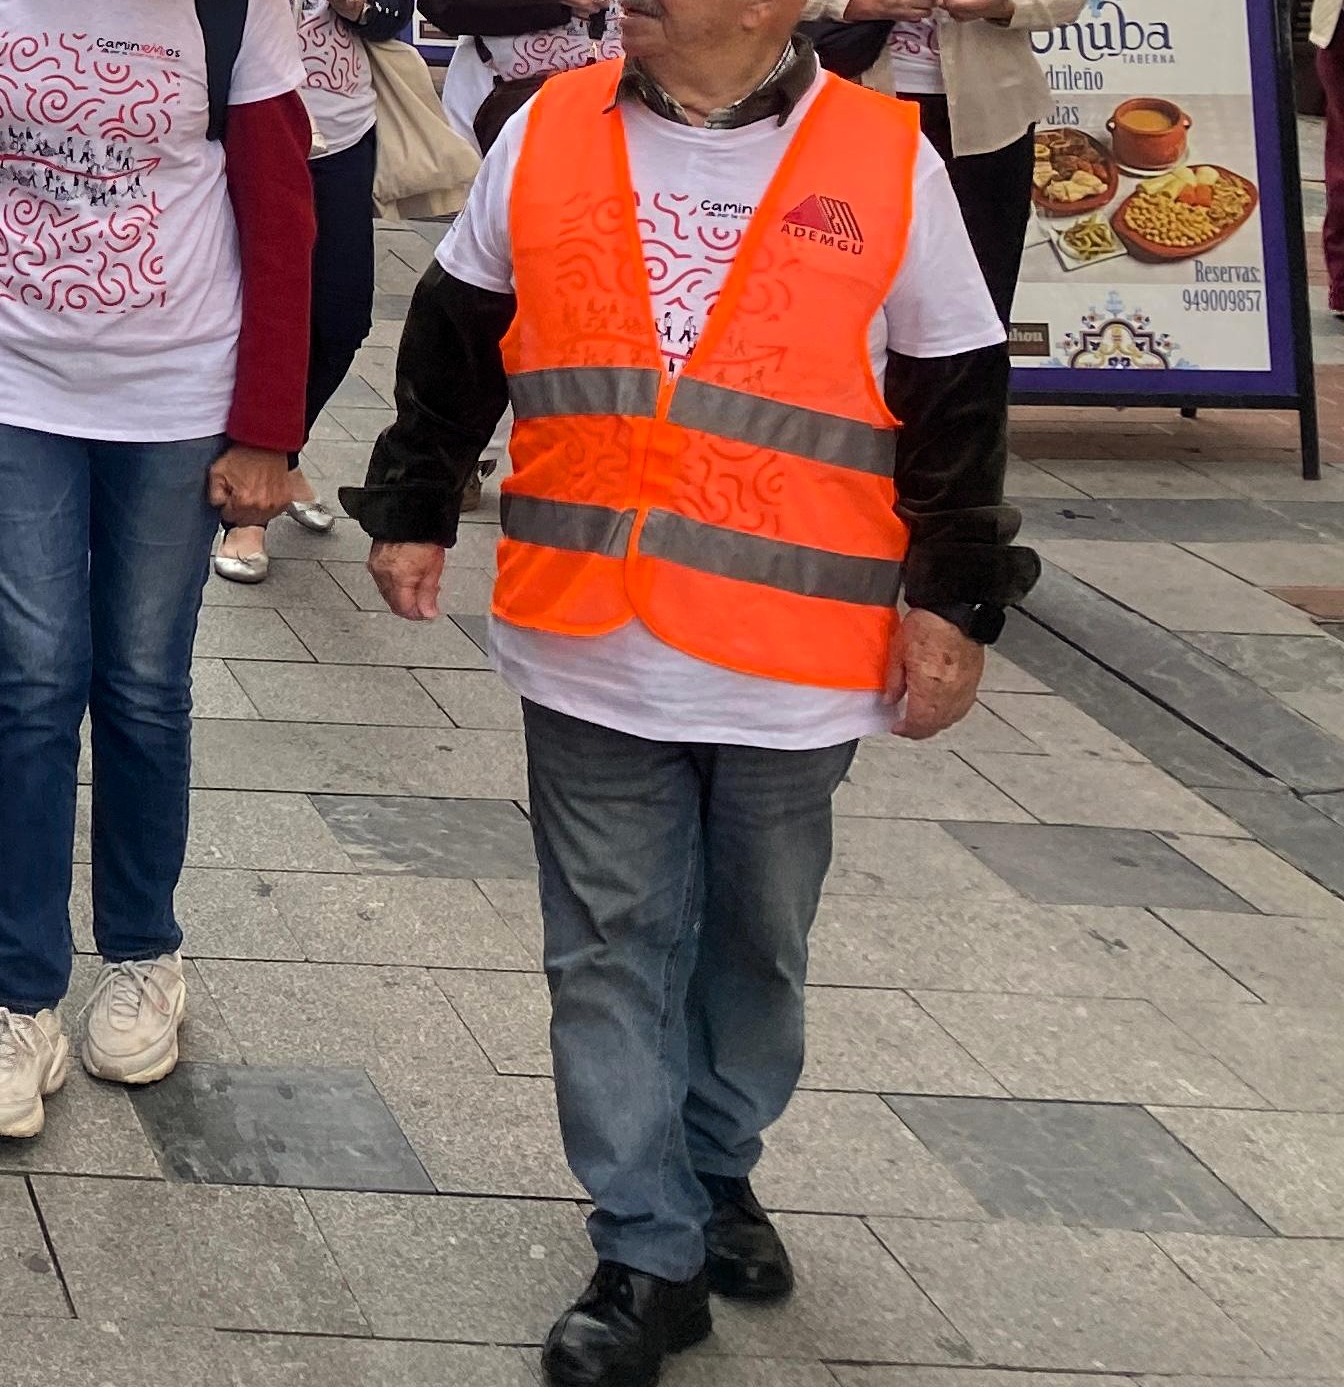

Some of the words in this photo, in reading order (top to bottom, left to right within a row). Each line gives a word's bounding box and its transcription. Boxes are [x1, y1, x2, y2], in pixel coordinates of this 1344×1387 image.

[1121, 53, 1176, 65] TABERNA
[1045, 64, 1104, 91] drileño
[700, 199, 758, 215] Camin
[780, 223, 864, 255] ADEMGU
[1182, 288, 1262, 313] 949009857
